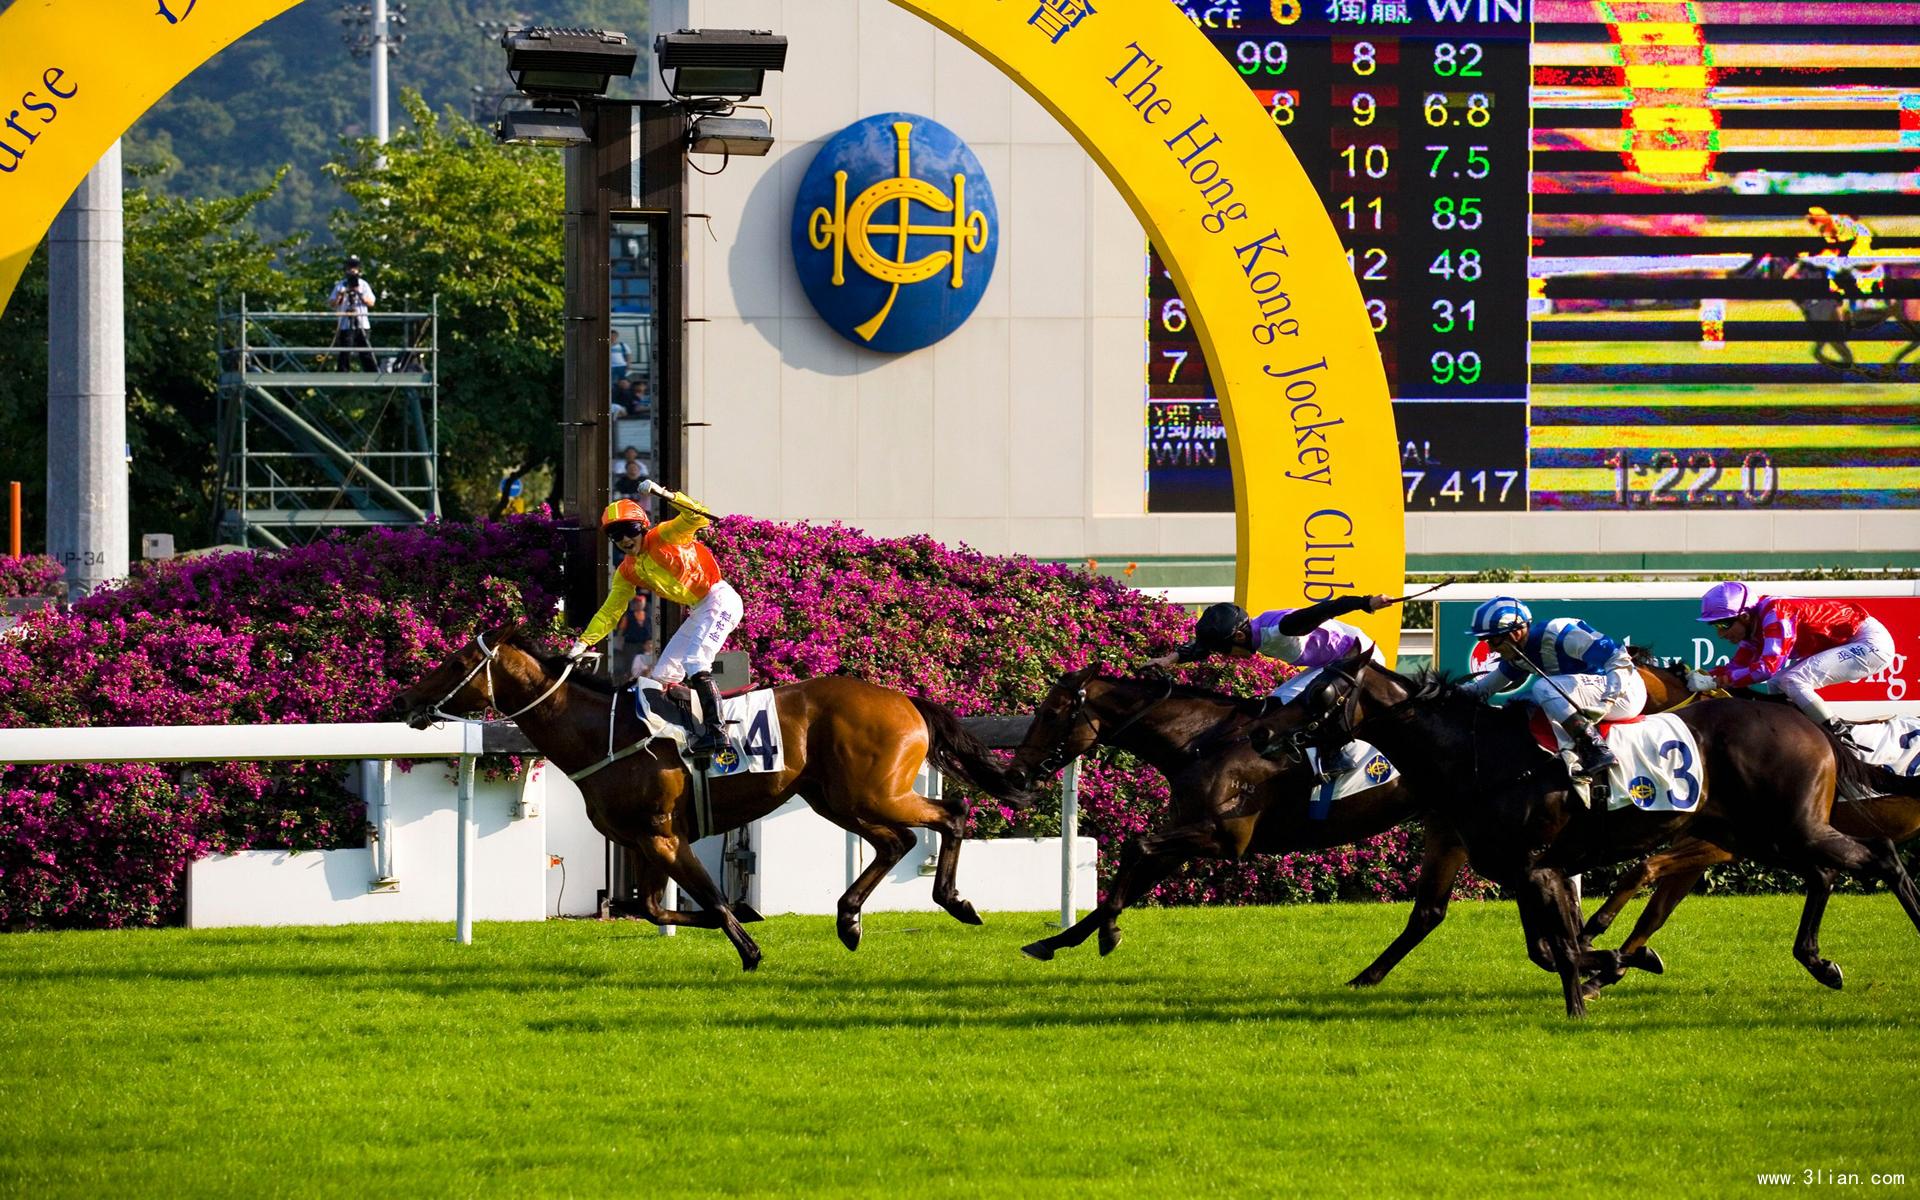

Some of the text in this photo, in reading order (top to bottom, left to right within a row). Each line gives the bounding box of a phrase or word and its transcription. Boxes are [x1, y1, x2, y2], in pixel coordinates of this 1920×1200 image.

[1427, 0, 1522, 23] WIN
[1237, 41, 1288, 75] 99
[1352, 42, 1483, 76] 8 82
[1352, 93, 1490, 127] 9 6.8
[1340, 145, 1490, 178] 10 7.5
[1340, 196, 1483, 230] 11 85
[1428, 248, 1482, 281] 48
[1105, 41, 1355, 603] The Hong Kong Jockey Club
[1162, 299, 1187, 332] 6
[1432, 299, 1475, 332] 31
[1162, 351, 1188, 383] 7
[1431, 351, 1482, 384] 99
[1151, 441, 1216, 466] WIN
[1604, 451, 1774, 503] 1:22.0
[56, 551, 105, 567] LP-34
[744, 709, 779, 771] 4
[1659, 740, 1700, 809] 3
